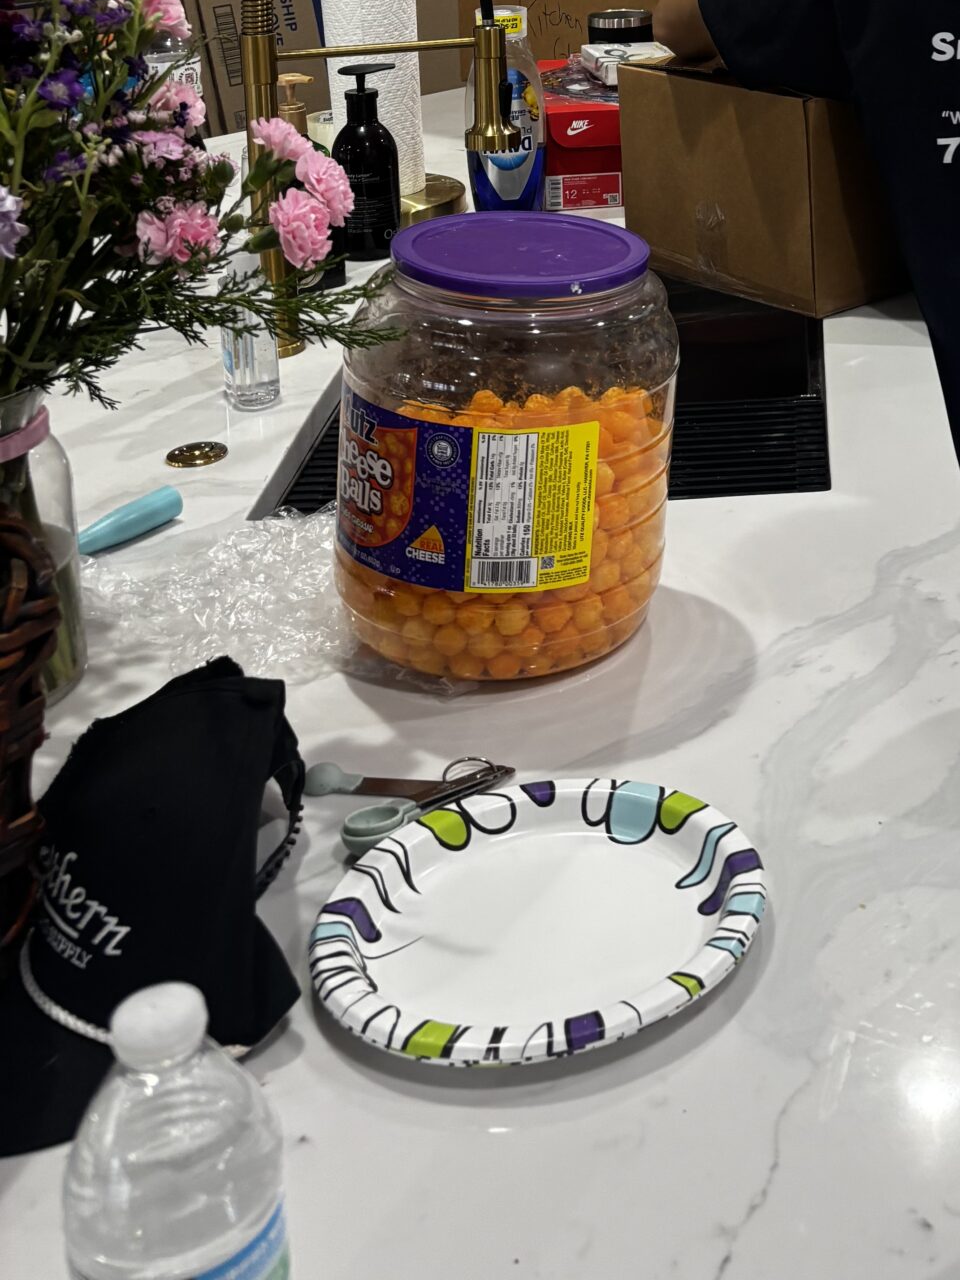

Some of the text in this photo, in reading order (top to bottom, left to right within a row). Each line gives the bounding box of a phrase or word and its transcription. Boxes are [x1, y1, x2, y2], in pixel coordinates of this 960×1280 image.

[571, 120, 590, 129] NIKE
[564, 189, 578, 200] 12
[340, 464, 381, 512] Balls
[406, 546, 446, 564] CHEESE
